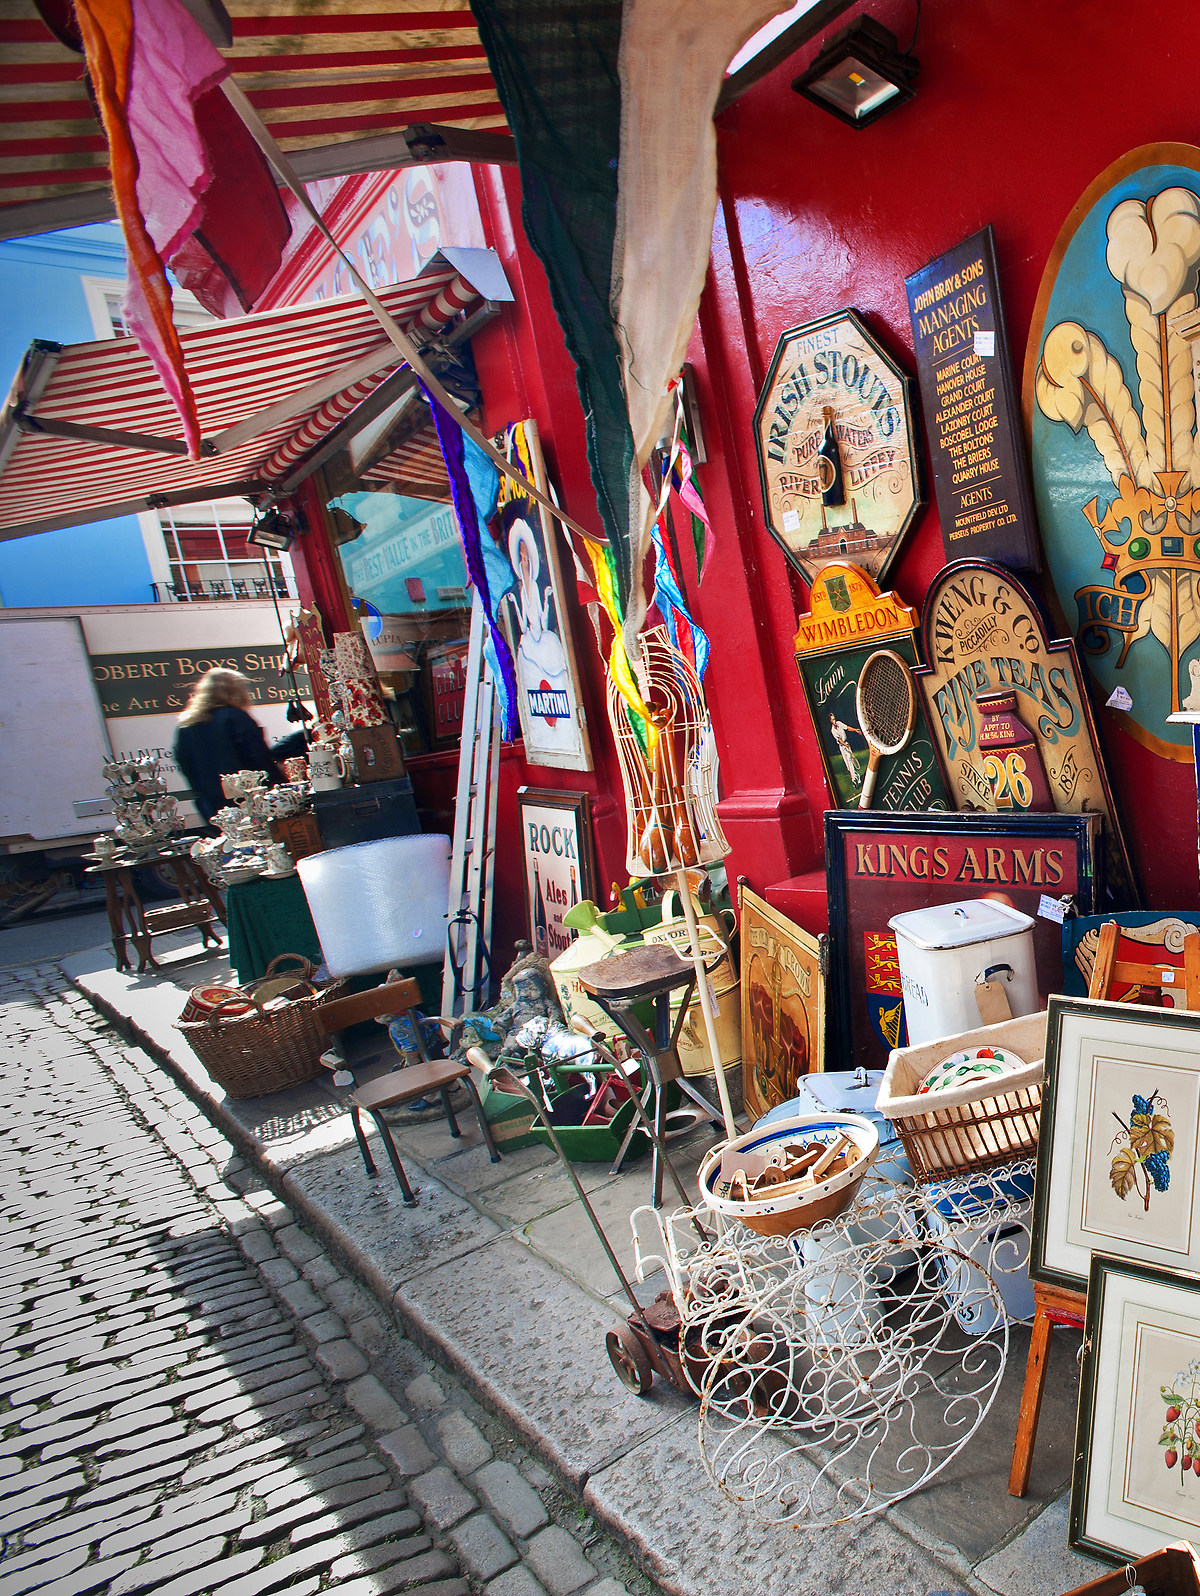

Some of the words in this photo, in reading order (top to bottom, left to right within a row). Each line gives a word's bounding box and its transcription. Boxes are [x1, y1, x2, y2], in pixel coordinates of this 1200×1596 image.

[914, 288, 935, 313] JOHN
[934, 276, 954, 301] BRAY
[954, 273, 962, 289] &
[961, 259, 984, 285] SONS
[918, 284, 986, 338] MANAGING
[796, 328, 839, 357] FINEST
[933, 315, 980, 356] AGENTS
[936, 361, 960, 382] MARINE
[936, 375, 965, 396] HANOVER
[965, 364, 986, 382] HOUSE
[767, 363, 812, 465] IRISH
[813, 350, 901, 437] STOUTS
[936, 399, 974, 423] ALEXANDER
[974, 387, 995, 406] COURT
[941, 389, 963, 407] GRAND
[964, 378, 985, 396] COURT
[940, 427, 974, 449] BOSCOBEL
[975, 416, 998, 435] LODGE
[941, 413, 971, 435] LAZONBY
[972, 403, 993, 421] COURT
[793, 430, 821, 463] PURE
[836, 424, 874, 447] WATERS
[948, 445, 963, 458] THE
[963, 432, 994, 454] BOLTONS
[952, 456, 967, 470] THE
[967, 447, 992, 465] BRIERS
[779, 476, 821, 495] RIVER
[850, 450, 896, 487] LIFFEY
[952, 466, 979, 485] QUARRY
[979, 458, 1000, 475] HOUSE
[961, 486, 993, 509] AGENTS
[949, 529, 970, 541] PERSEUS
[970, 520, 996, 535] PROPERTY
[955, 511, 987, 528] MOUNTFIELD
[384, 537, 411, 570] VALUE
[802, 606, 900, 643] WIMBLEDON
[936, 576, 988, 665] KWENG
[1084, 593, 1138, 625] ICH
[960, 615, 998, 653] PICCADILLY
[814, 664, 846, 707] Lawn
[128, 697, 160, 712] Art
[167, 695, 183, 707] &
[528, 692, 570, 715] MARTINI
[991, 715, 1000, 723] BY
[999, 730, 1015, 739] KING
[1000, 722, 1011, 731] TO
[882, 751, 923, 811] TENNIS
[960, 762, 991, 800] SINCE
[1058, 753, 1079, 795] 1827
[984, 753, 1033, 808] 26
[528, 823, 576, 859] ROCK
[854, 844, 949, 879] KINGS
[954, 847, 1064, 886] ARMS
[546, 879, 567, 906] Ales
[548, 923, 571, 951] Stout
